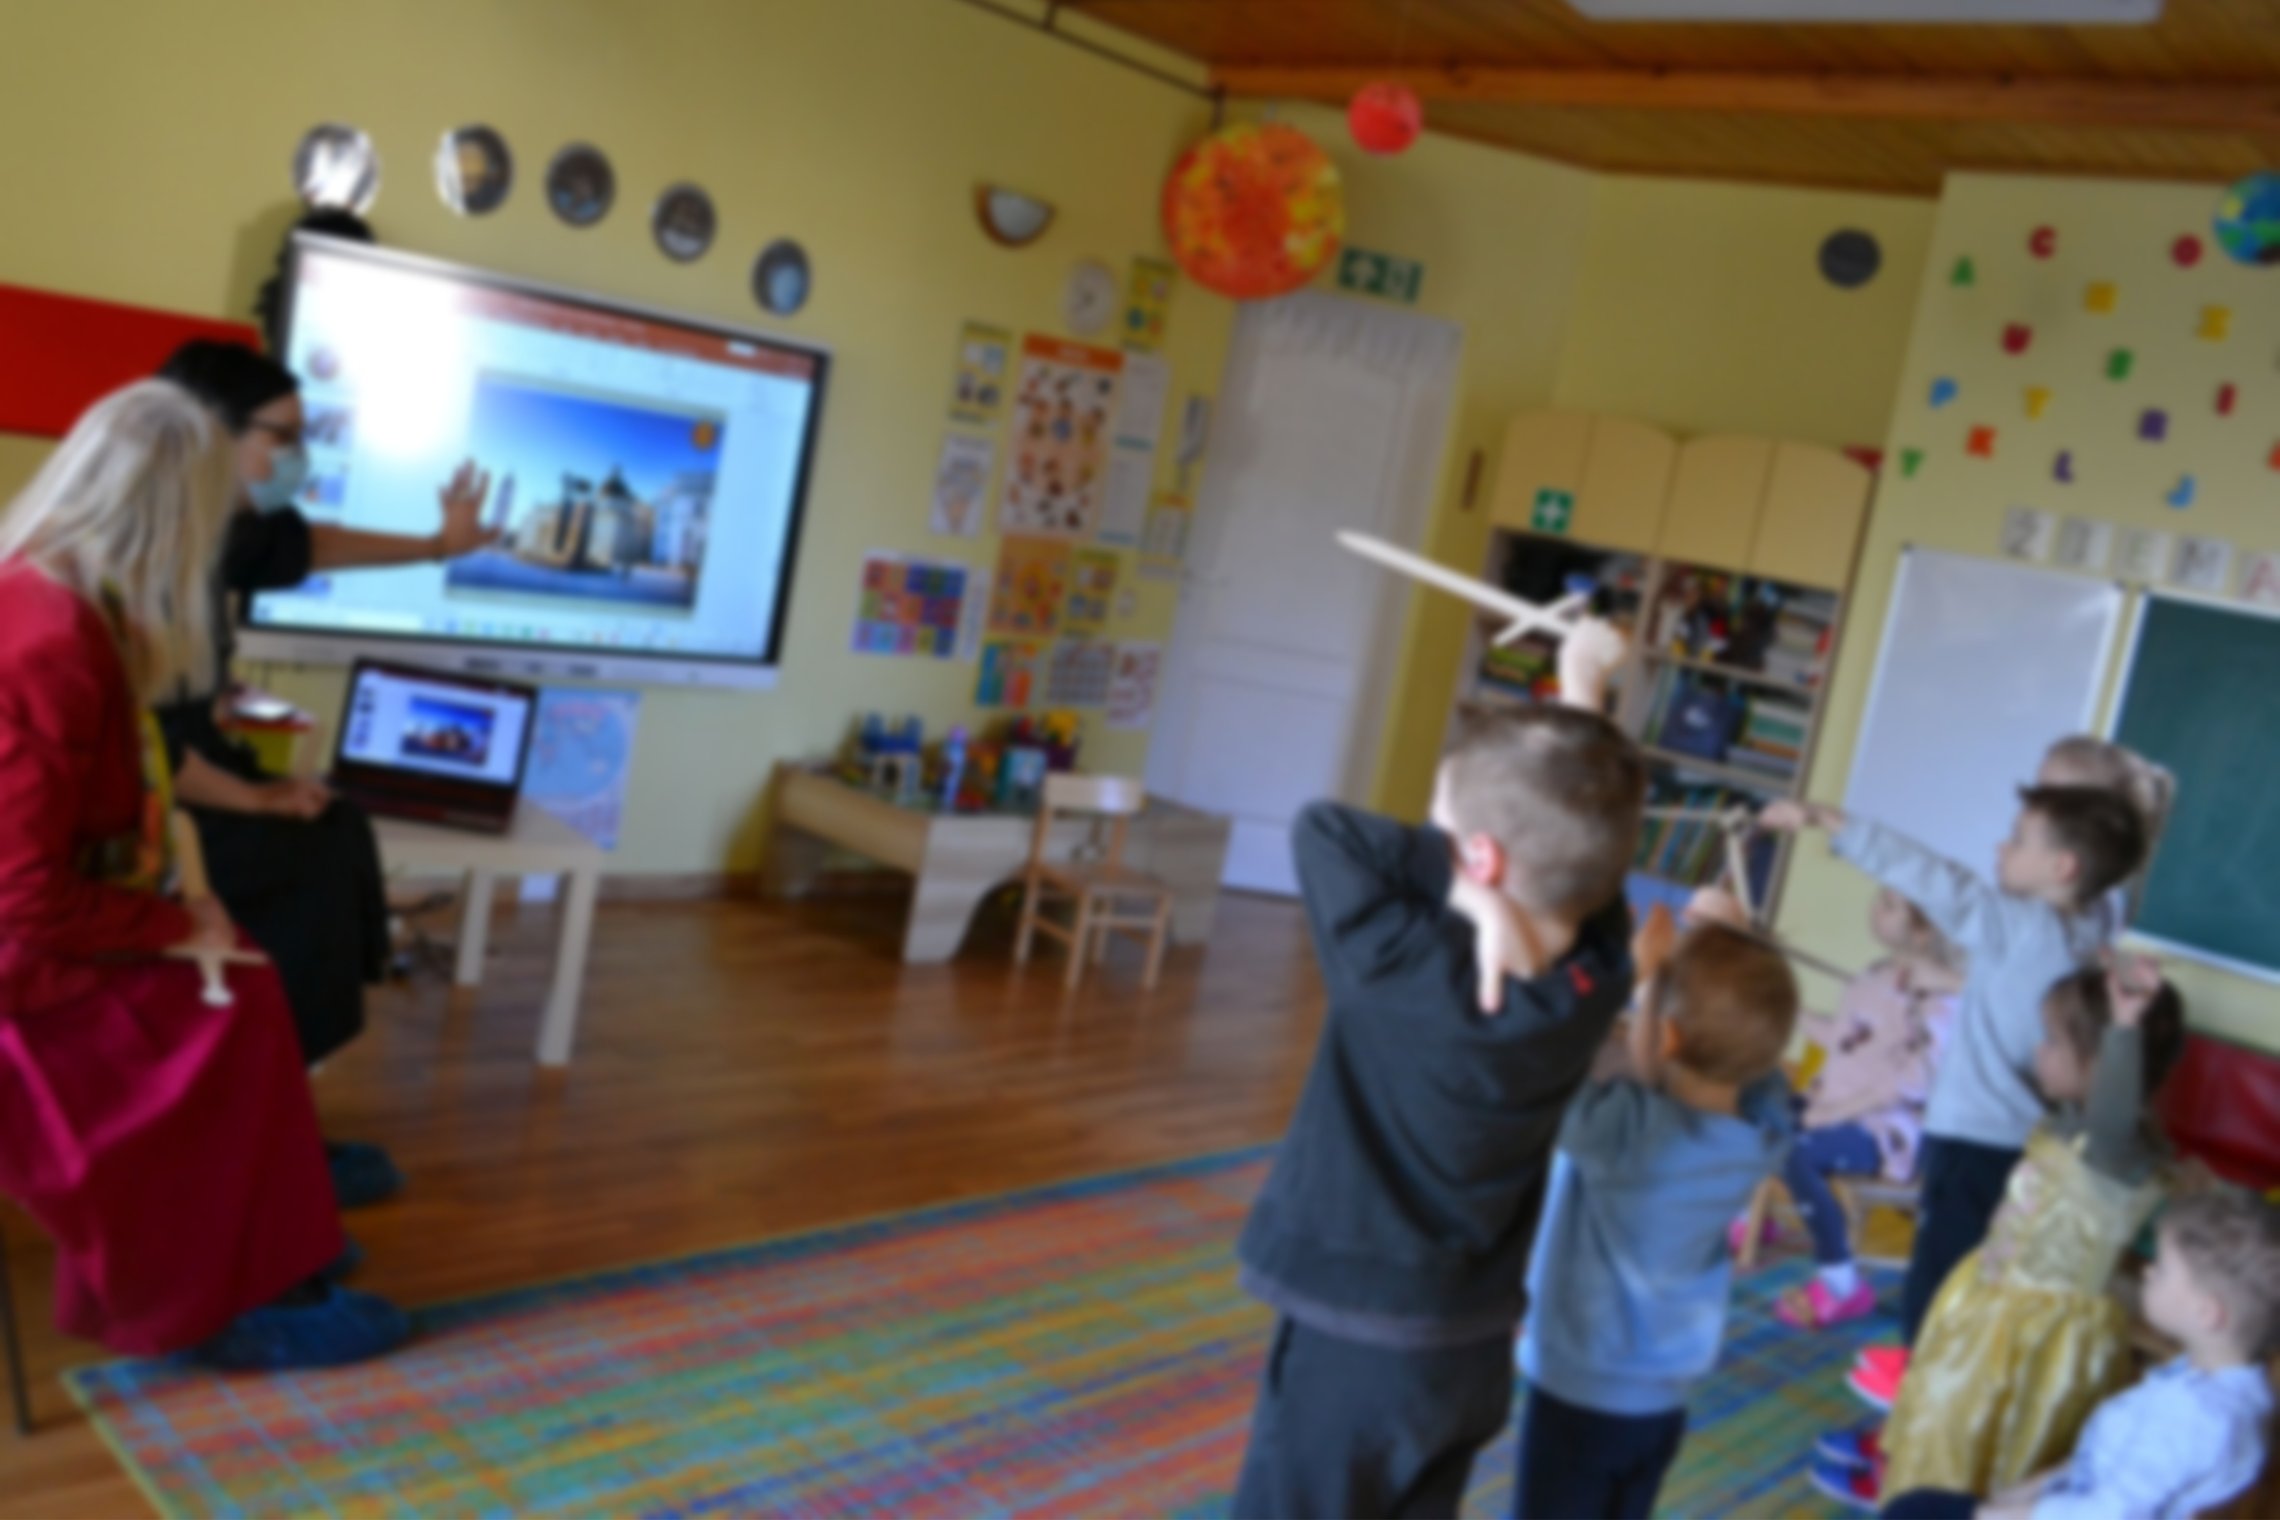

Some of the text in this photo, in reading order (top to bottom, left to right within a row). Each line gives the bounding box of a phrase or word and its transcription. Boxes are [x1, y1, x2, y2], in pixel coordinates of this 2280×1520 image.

[2030, 227, 2055, 257] C
[2172, 236, 2202, 267] O
[1951, 257, 1974, 285] A
[2002, 324, 2031, 354] U
[2106, 349, 2133, 379] S
[1930, 378, 1957, 407] P
[1966, 426, 1996, 457] K
[2054, 451, 2073, 482] L
[2166, 476, 2194, 507] J
